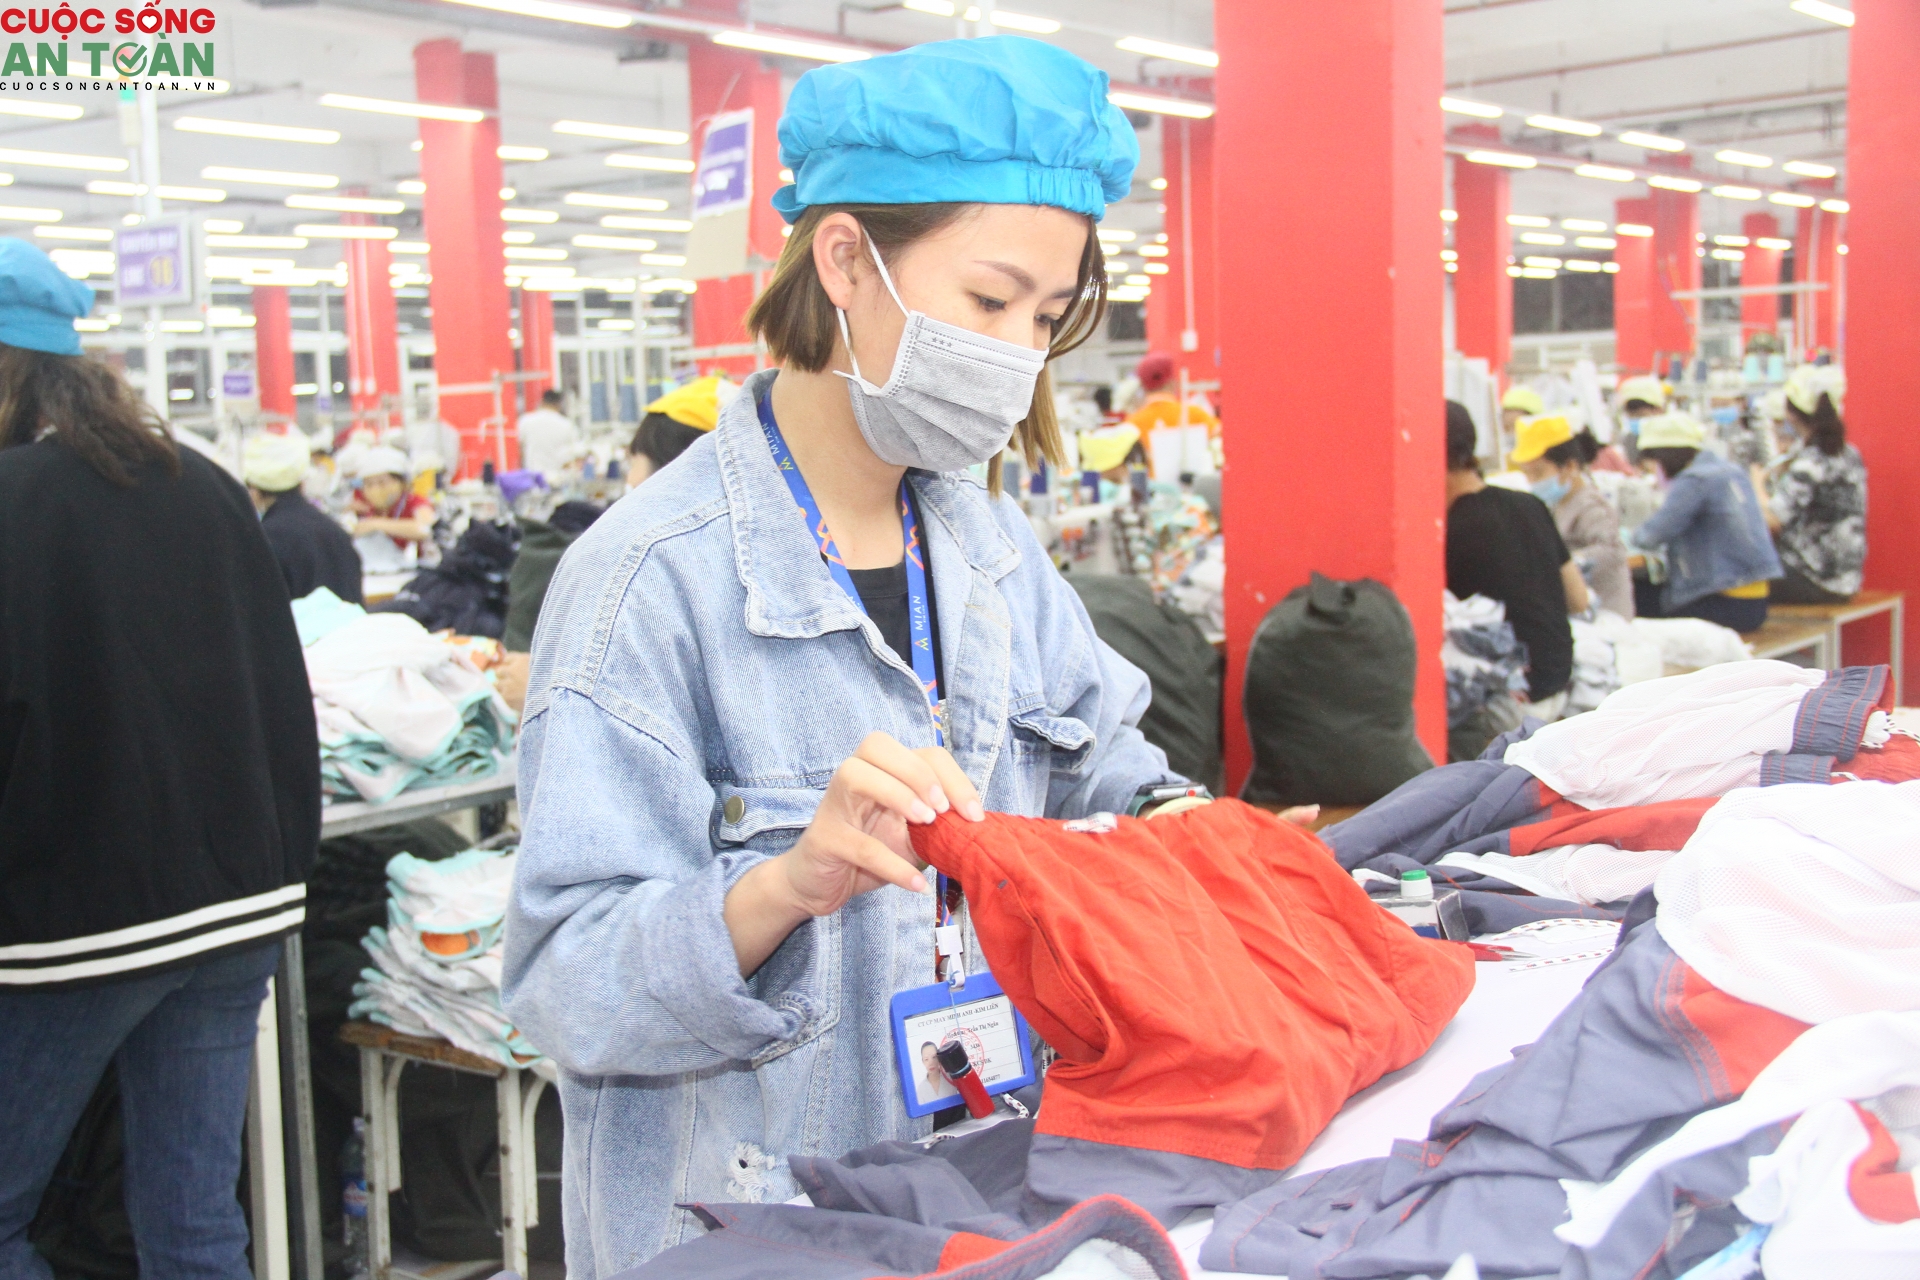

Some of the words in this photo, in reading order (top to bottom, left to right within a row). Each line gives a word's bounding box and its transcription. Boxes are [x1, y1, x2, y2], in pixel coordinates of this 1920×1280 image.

[762, 422, 780, 455] MIAN
[912, 595, 924, 631] MIAN
[933, 1015, 947, 1024] MAY
[961, 1009, 974, 1018] ANH
